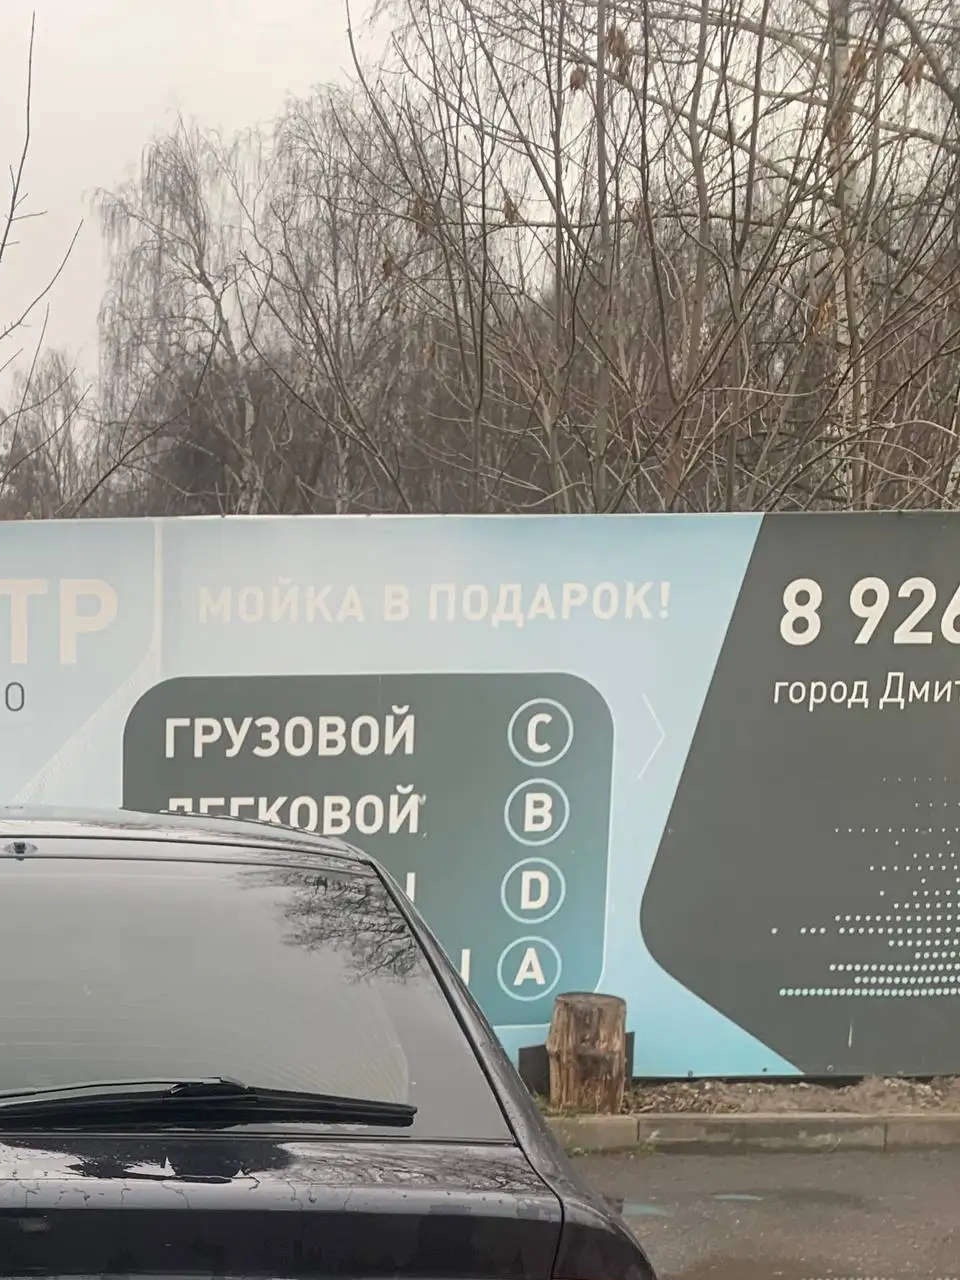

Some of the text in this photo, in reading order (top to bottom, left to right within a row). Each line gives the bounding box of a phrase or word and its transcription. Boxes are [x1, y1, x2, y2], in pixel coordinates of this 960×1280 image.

[198, 576, 671, 627] МОЙКА В ПОДАРОК!
[780, 578, 823, 645] 8
[774, 671, 960, 712] город Дми
[165, 705, 415, 758] ГРУЗОВОЙ
[520, 871, 549, 910] D
